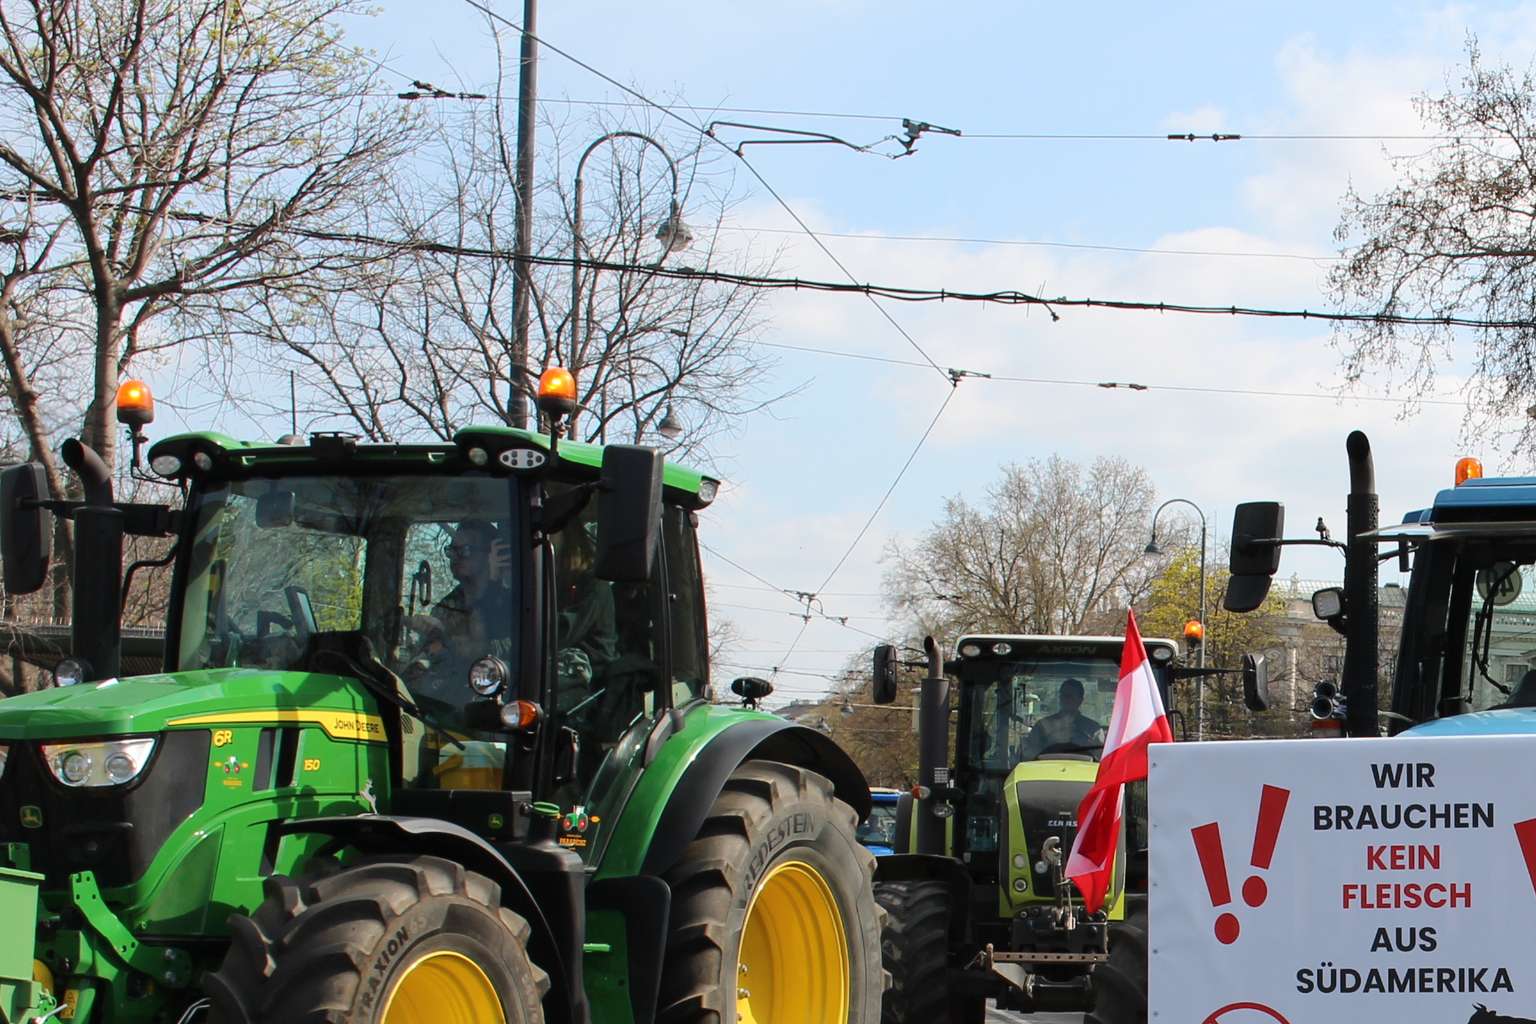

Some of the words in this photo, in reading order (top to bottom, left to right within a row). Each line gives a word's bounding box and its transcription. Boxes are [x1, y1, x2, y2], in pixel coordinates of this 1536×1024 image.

[213, 730, 233, 748] 6R
[334, 717, 355, 730] JOHN
[355, 719, 380, 734] DEERE
[303, 759, 321, 771] 150
[1370, 762, 1435, 789] WIR
[1313, 802, 1494, 831] BRAUCHEN
[743, 811, 816, 899] REDESTEIN
[1367, 844, 1441, 870] KEIN
[1342, 882, 1473, 910] FLEISCH
[1370, 926, 1437, 953] AUS
[358, 926, 409, 1019] TRAXION
[1296, 961, 1514, 994] SÜDAMERIKA
